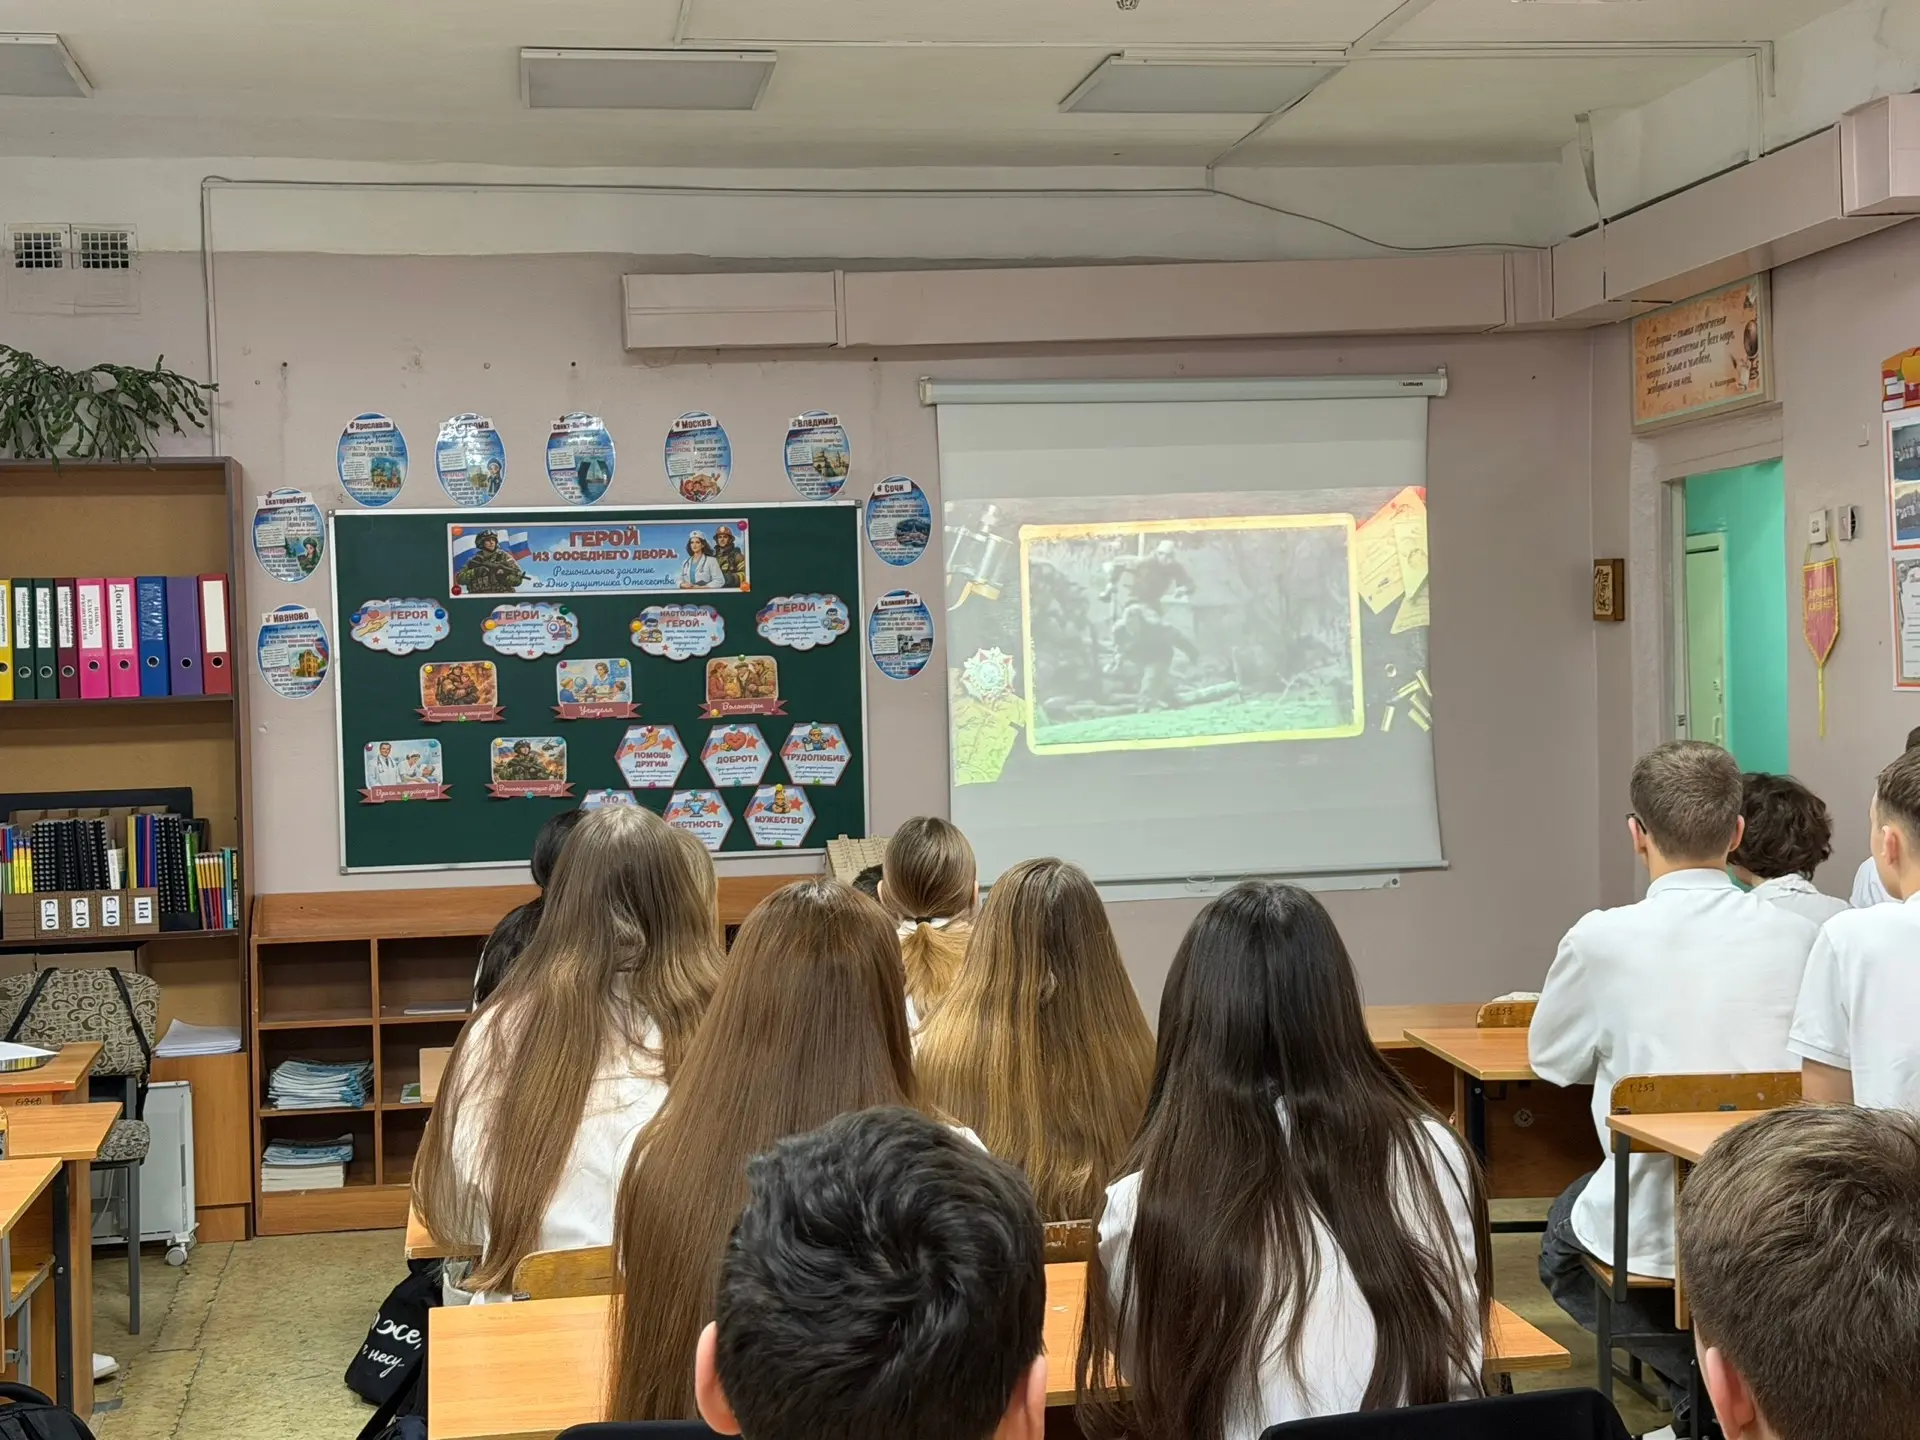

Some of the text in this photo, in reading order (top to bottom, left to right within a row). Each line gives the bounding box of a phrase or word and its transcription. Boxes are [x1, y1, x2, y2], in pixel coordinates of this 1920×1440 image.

[797, 417, 838, 427] Владимир
[884, 484, 905, 493] Сочи
[265, 496, 307, 506] Екатеринбург
[569, 525, 640, 547] ГЕРОЙ
[532, 551, 550, 562] ИЗ
[553, 550, 630, 562] СОСЕДНЕГО
[552, 566, 655, 579] Региональное занятие
[545, 577, 568, 588] Дню
[570, 580, 621, 592] защитника
[623, 575, 676, 586] Отечества
[776, 602, 816, 612] ГЕРОИ
[880, 598, 918, 606] Калининград
[86, 598, 94, 635] КЛАССНОГО
[114, 585, 125, 648] Достижения
[273, 612, 309, 623] Иваново
[390, 610, 429, 620] ГЕРОЯ
[499, 610, 540, 620] ГЕРОИ
[666, 618, 700, 628] ГЕРОЙ
[634, 751, 671, 759] ПОМОЩЬ
[716, 754, 759, 764] ДОБРОТА
[786, 753, 846, 762] ТРУДОЛЮБИЕ
[635, 760, 669, 768] ДРУГИМ
[754, 815, 804, 824] МУЖЕСТВО
[44, 901, 56, 929] ОГЭ
[75, 899, 88, 927] ОГЭ
[106, 897, 117, 925] ОГЭ
